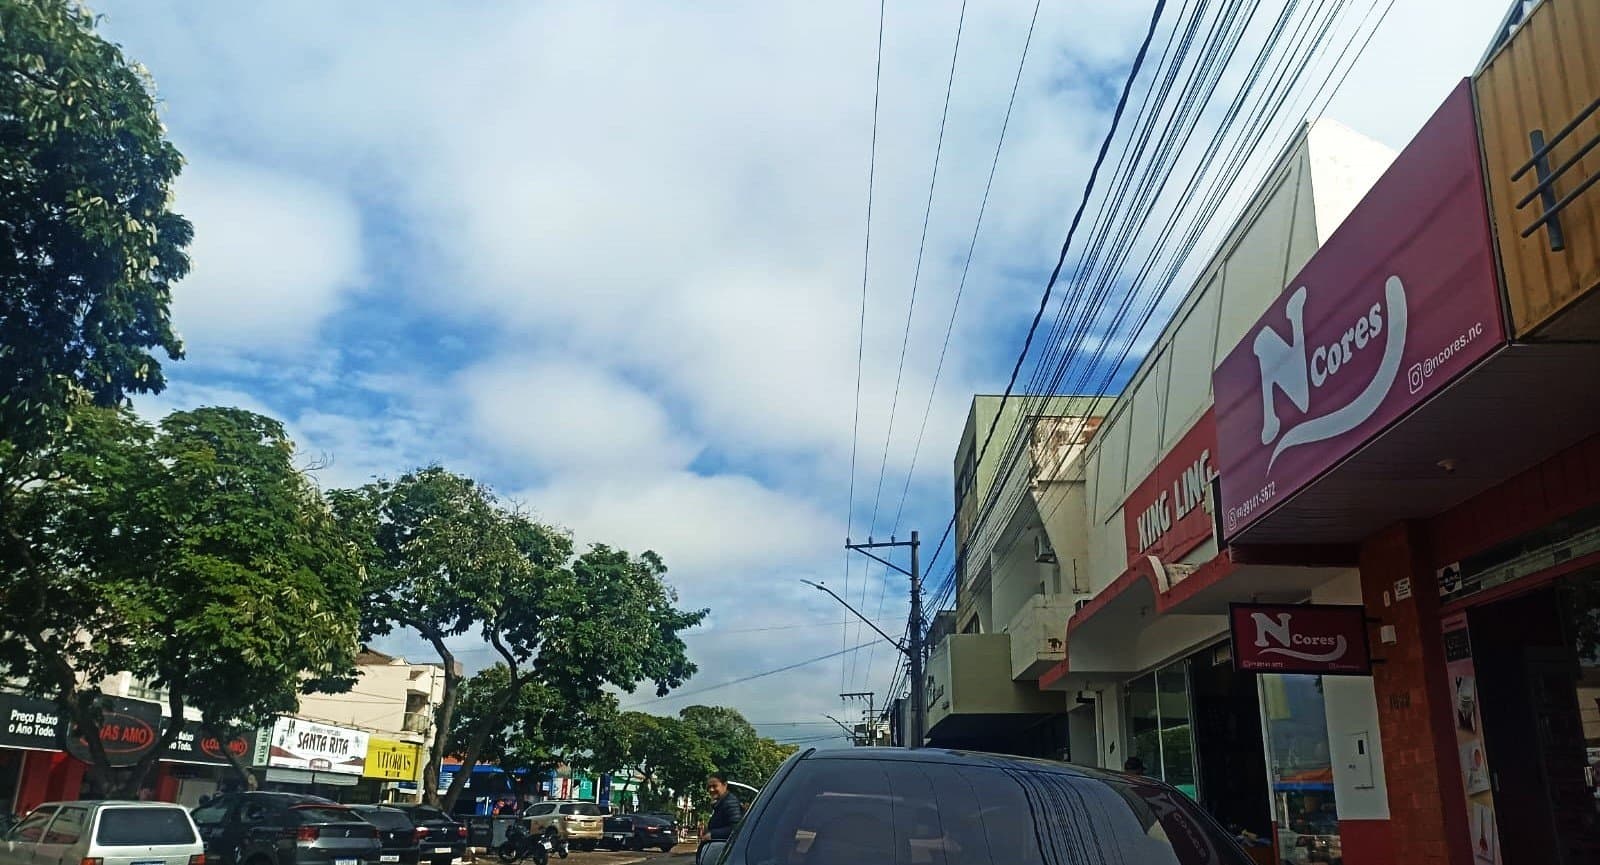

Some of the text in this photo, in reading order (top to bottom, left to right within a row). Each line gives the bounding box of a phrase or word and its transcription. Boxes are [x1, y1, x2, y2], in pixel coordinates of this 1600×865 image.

[1253, 285, 1310, 444] N
[1422, 321, 1484, 377] @ncores.nc
[1136, 490, 1172, 553] XING
[1250, 611, 1336, 649] N Cores
[8, 723, 56, 738] o Ano Todo.
[9, 709, 58, 726] Preço Baixo
[120, 726, 147, 743] AMO
[297, 731, 327, 752] SANTA
[328, 737, 350, 756] RITA
